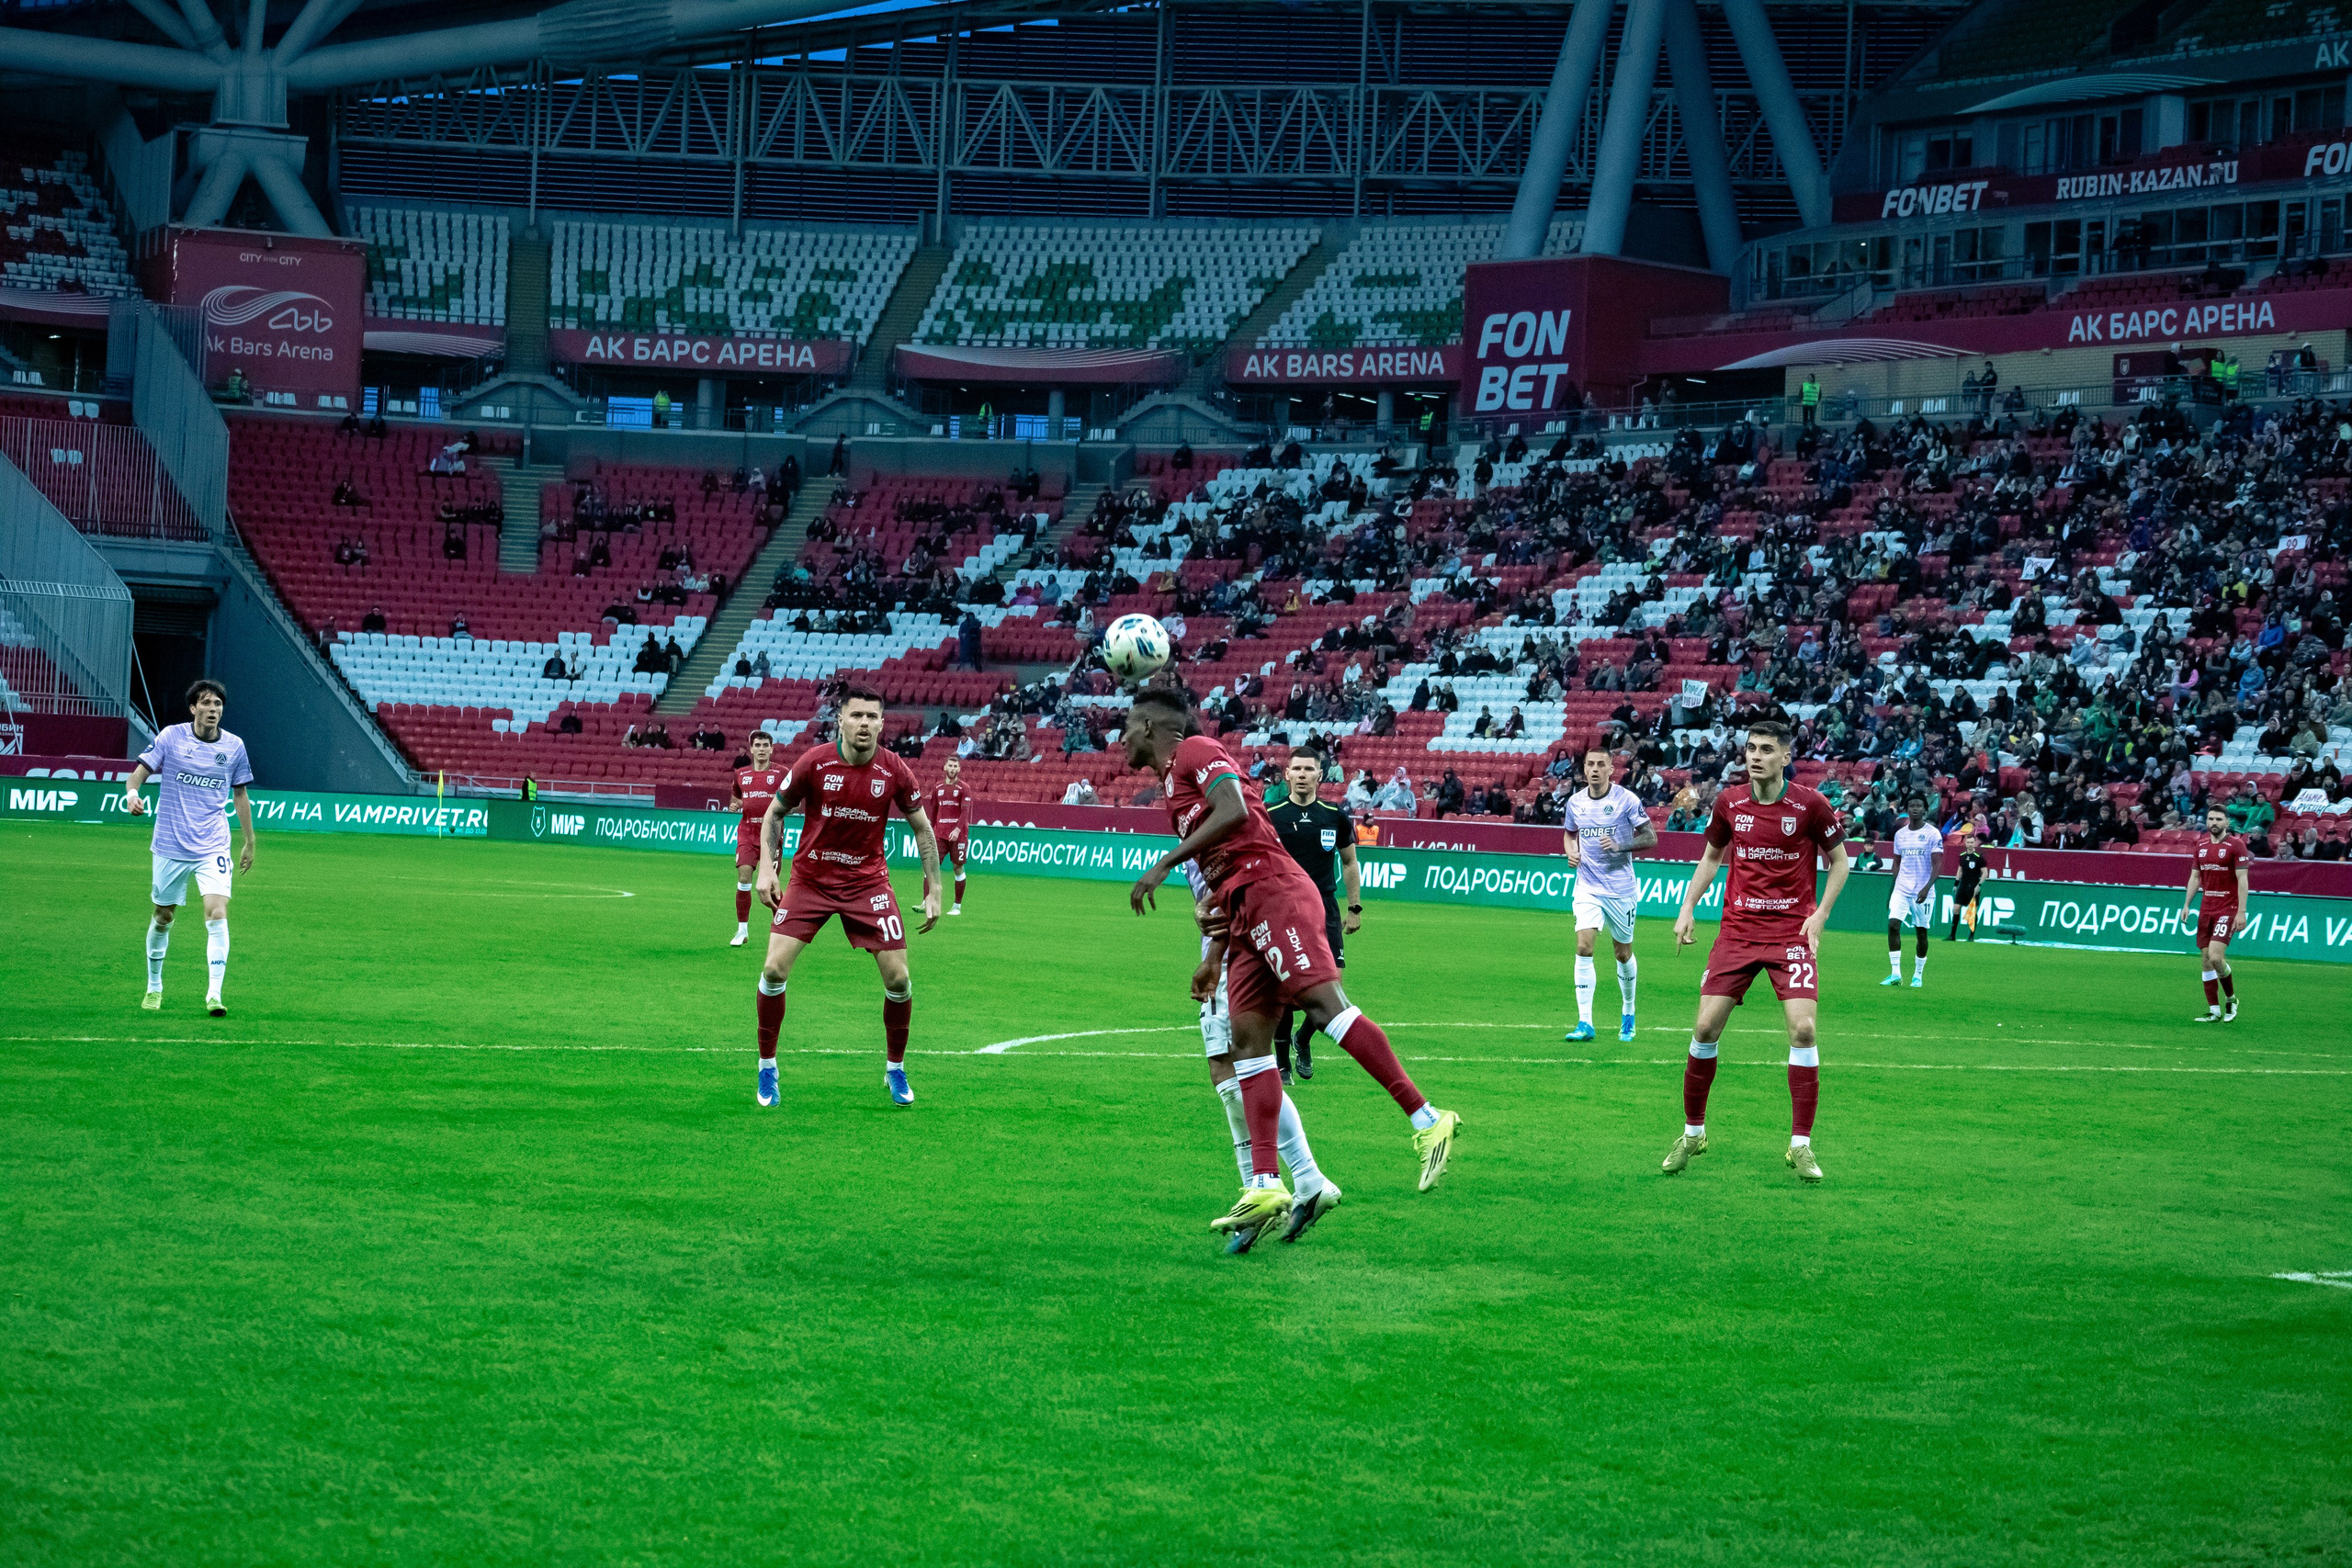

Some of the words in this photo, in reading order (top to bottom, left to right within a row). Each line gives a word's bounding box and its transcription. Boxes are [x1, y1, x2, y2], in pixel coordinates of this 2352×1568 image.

[2056, 161, 2238, 200] RUBIN-KAZAN.RU
[1882, 181, 1988, 219] FONBET
[240, 253, 263, 263] CITY
[279, 256, 302, 266] CITY
[2069, 315, 2102, 342] АК
[2110, 308, 2177, 340] БАРС
[2184, 300, 2275, 333] АРЕНА
[1476, 310, 1571, 359] FON
[231, 337, 273, 356] Bars
[277, 341, 334, 361] Arena
[585, 336, 625, 359] АК
[634, 338, 710, 364] БАРС
[718, 343, 816, 367] АРЕНА
[1243, 355, 1279, 378] AK
[1286, 354, 1353, 378] BARS
[1360, 351, 1444, 376] ARENA
[1475, 363, 1568, 412] BET
[0, 723, 24, 732] БИН
[175, 773, 225, 790] FONBET
[823, 782, 843, 791] BET
[824, 774, 844, 784] FON
[10, 788, 79, 811] МИР
[290, 802, 322, 821] НА
[334, 803, 488, 828] VAMPRIVET.R
[834, 806, 869, 817] КАЗАНЬ
[551, 814, 585, 835] МИР
[595, 818, 695, 840] ПОДРОБНОСТИ
[697, 823, 717, 842] НА
[1735, 814, 1754, 824] FON
[1735, 823, 1753, 832] BET
[1579, 827, 1617, 838] FONBET
[1091, 846, 1113, 868] НА
[1748, 846, 1784, 854] КАЗАНЬ
[1357, 861, 1407, 889] МИР
[870, 893, 888, 905] FON
[873, 900, 890, 912] BET
[1745, 902, 1790, 910] НЕФТЕХИМ
[1746, 897, 1799, 905] НИЖНЕКАМСК
[1924, 903, 1930, 915] 11
[877, 915, 903, 942] 10
[1250, 919, 1269, 941] FON
[2040, 900, 2263, 941] ПОДРОБНОИ
[2267, 914, 2309, 943] НА
[2213, 923, 2228, 937] 99
[1256, 931, 1272, 951] BET
[1787, 952, 1806, 960] BET
[1788, 963, 1815, 989] 22
